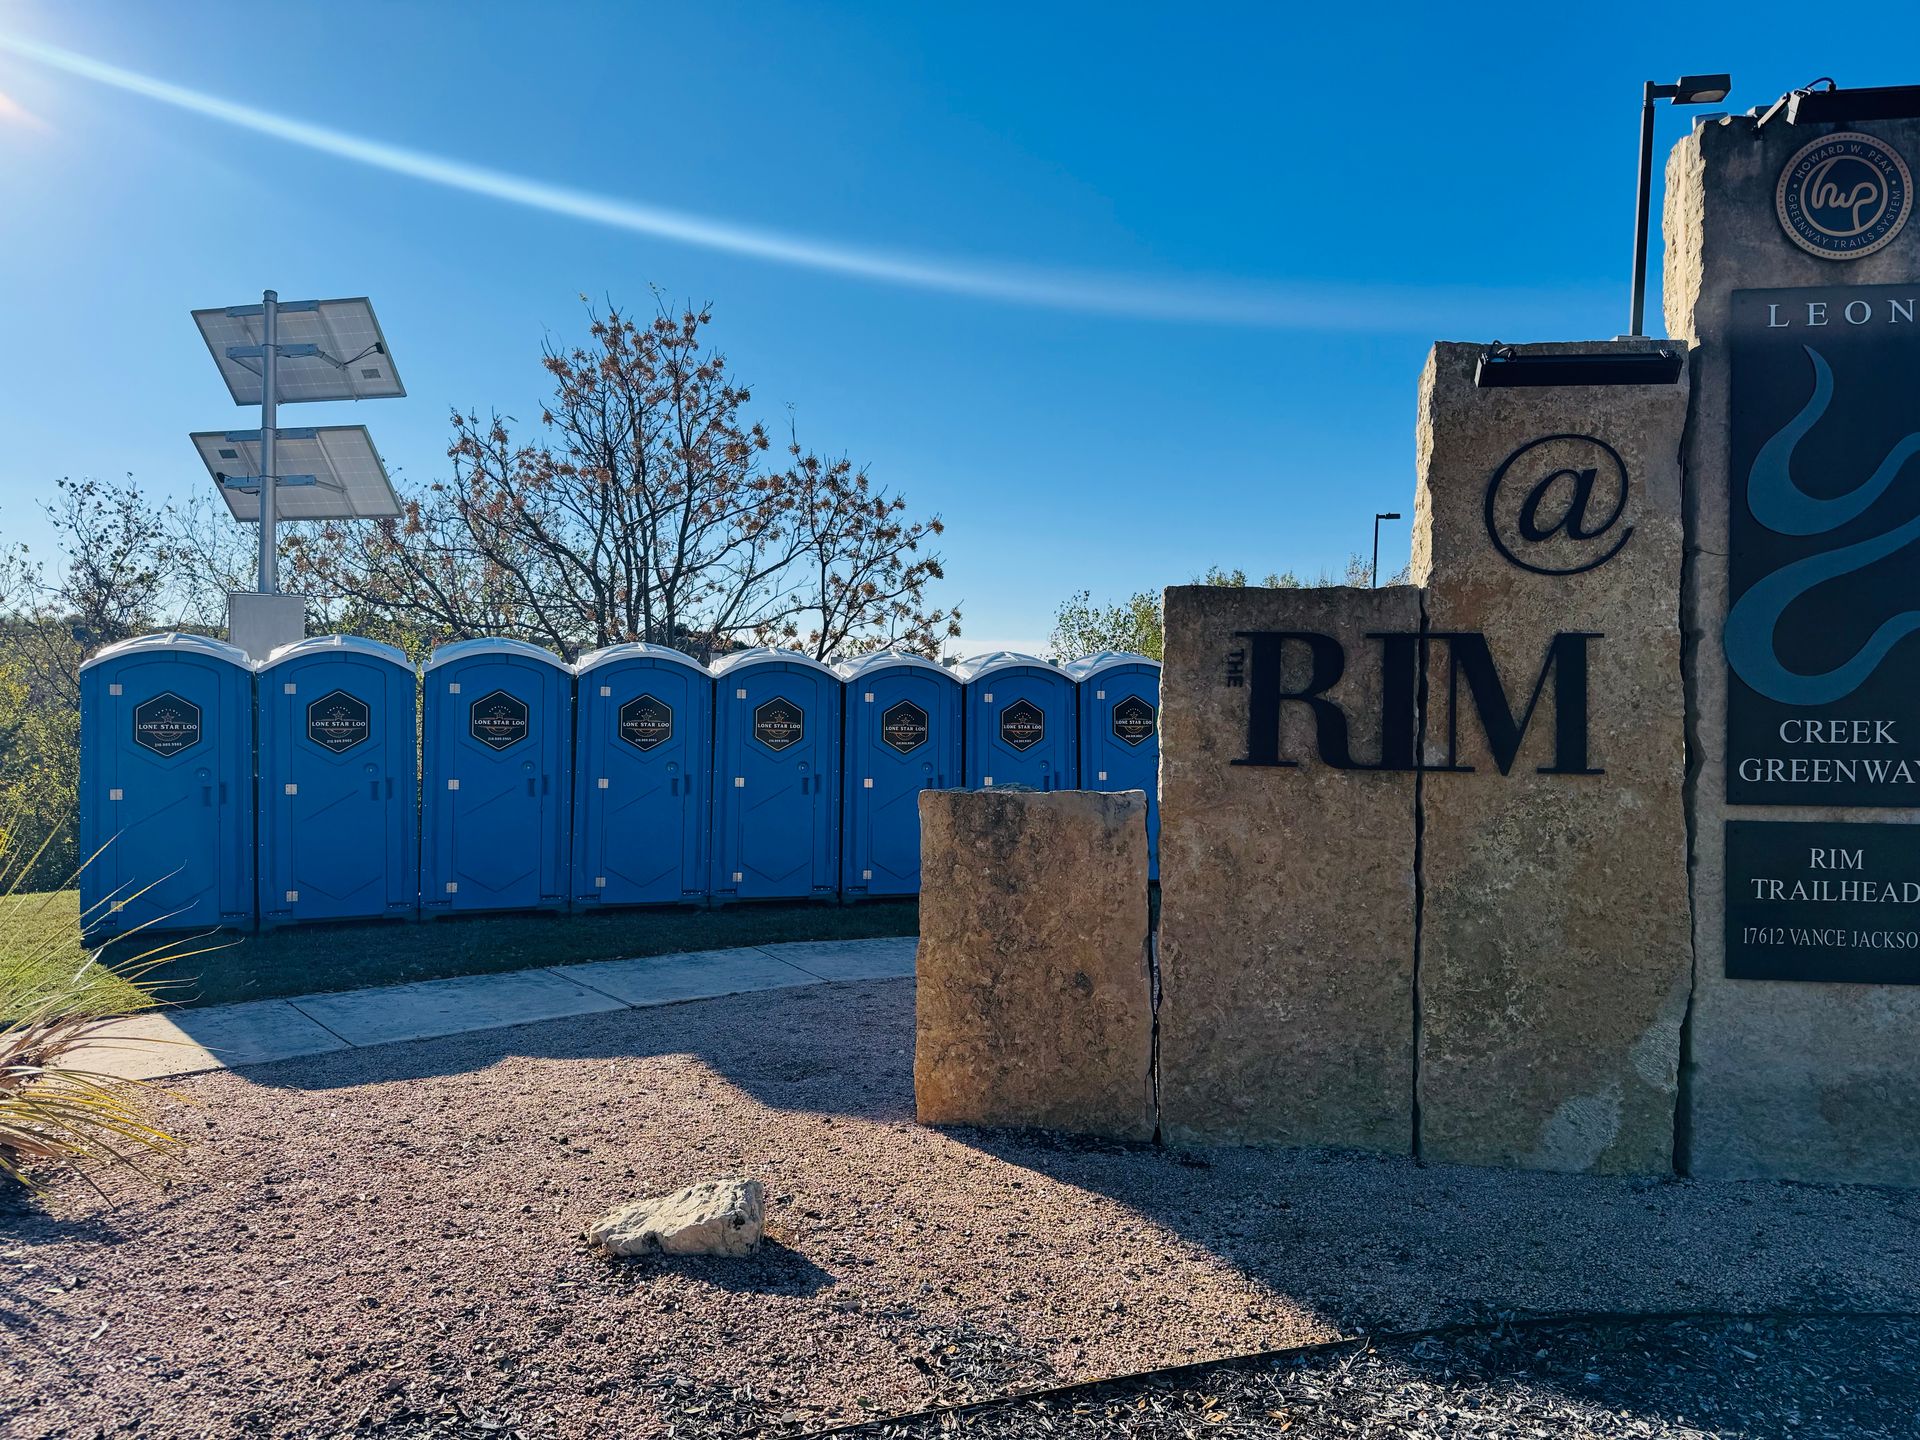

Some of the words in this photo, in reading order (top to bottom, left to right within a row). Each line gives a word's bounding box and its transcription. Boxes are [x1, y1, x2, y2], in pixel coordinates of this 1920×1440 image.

[1795, 144, 1844, 179] HOWARD
[1850, 145, 1863, 155] W.
[1868, 150, 1894, 175] PEAK
[1788, 194, 1829, 245] GREENWAY
[1834, 233, 1875, 248] TRAILS
[1877, 190, 1900, 233] SYSTEM
[1768, 299, 1916, 328] LEON
[1485, 434, 1633, 575] @
[1228, 649, 1245, 688] THE
[1230, 632, 1605, 776] RIM
[1779, 719, 1899, 744] CREEK
[1809, 848, 1864, 870] RIM
[1751, 878, 1920, 903] TRAILHEAD
[1743, 927, 1785, 945] 17612
[1789, 928, 1847, 946] VANCE
[1851, 930, 1920, 948] JACKSO
